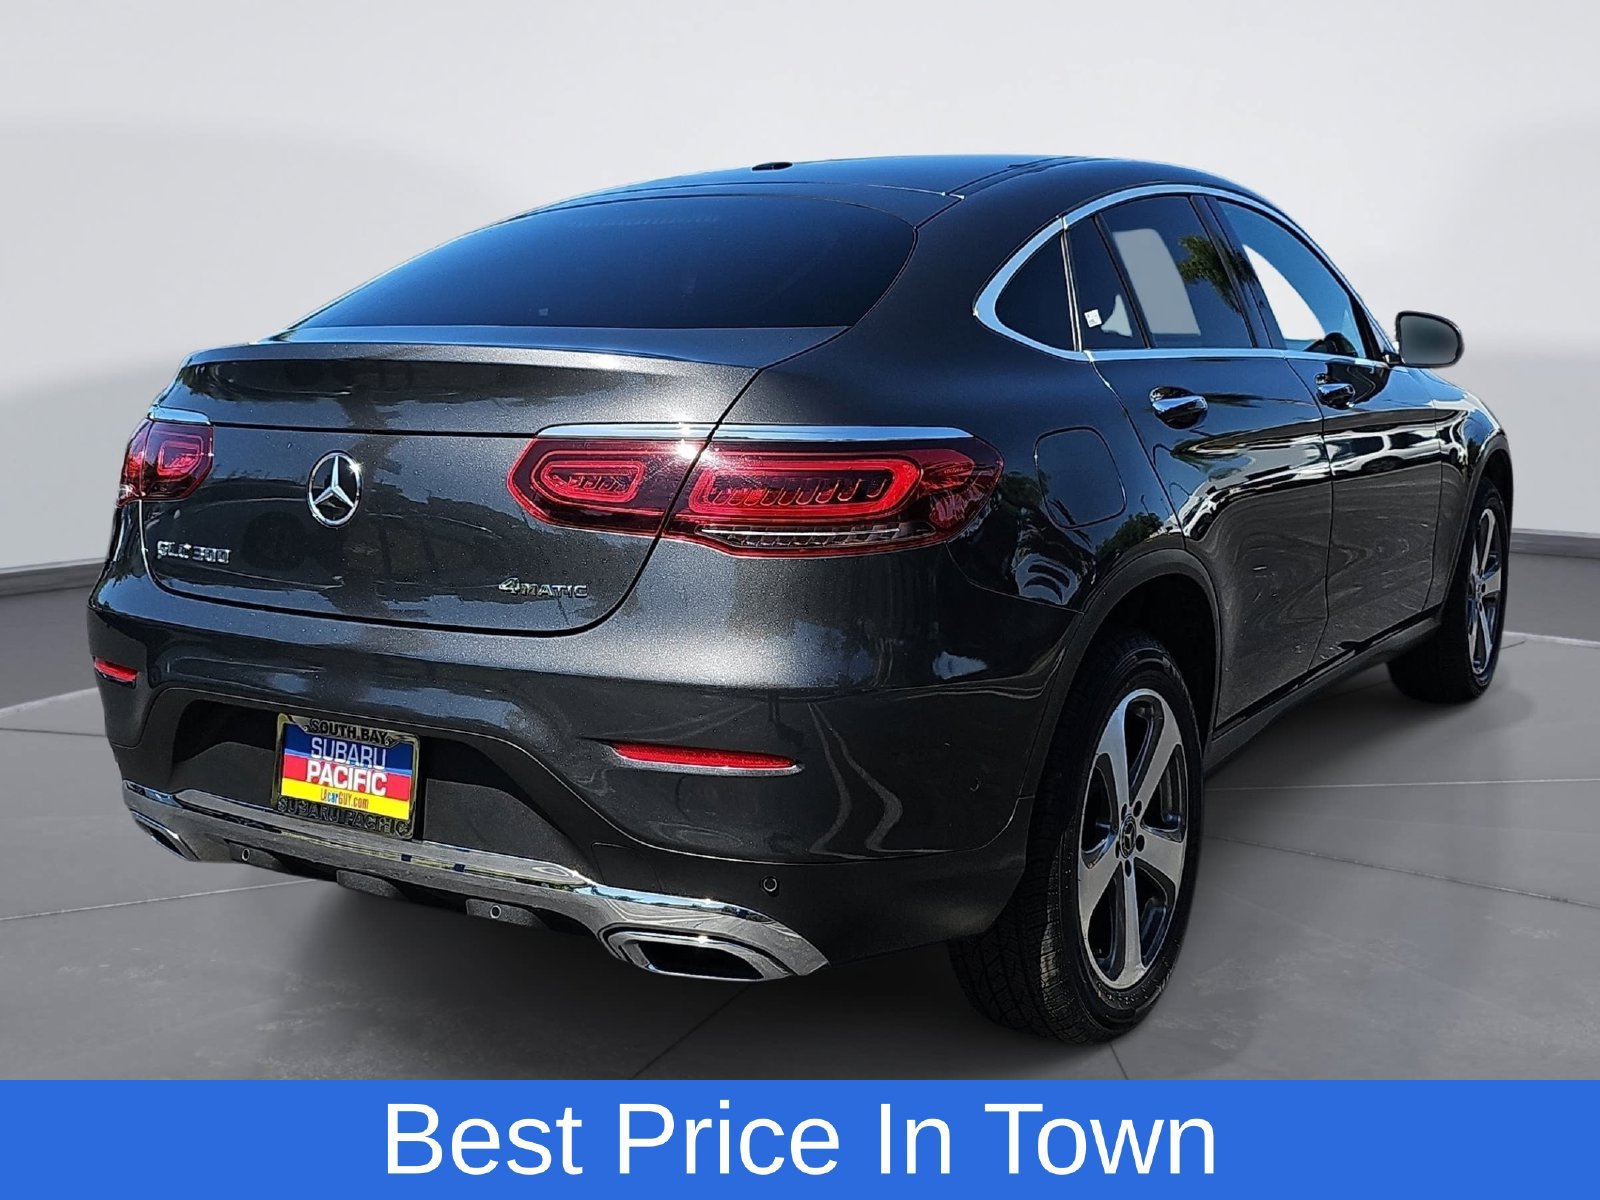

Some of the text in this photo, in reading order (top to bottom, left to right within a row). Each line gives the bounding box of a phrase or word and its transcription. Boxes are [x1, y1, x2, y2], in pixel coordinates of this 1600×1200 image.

[157, 540, 231, 563] GLC 300
[498, 577, 588, 597] 4MATIC
[309, 718, 388, 745] SOUTH BAY
[311, 737, 386, 769] SUBARU
[306, 760, 388, 796] PACIFIC
[277, 798, 340, 822] SUBARU
